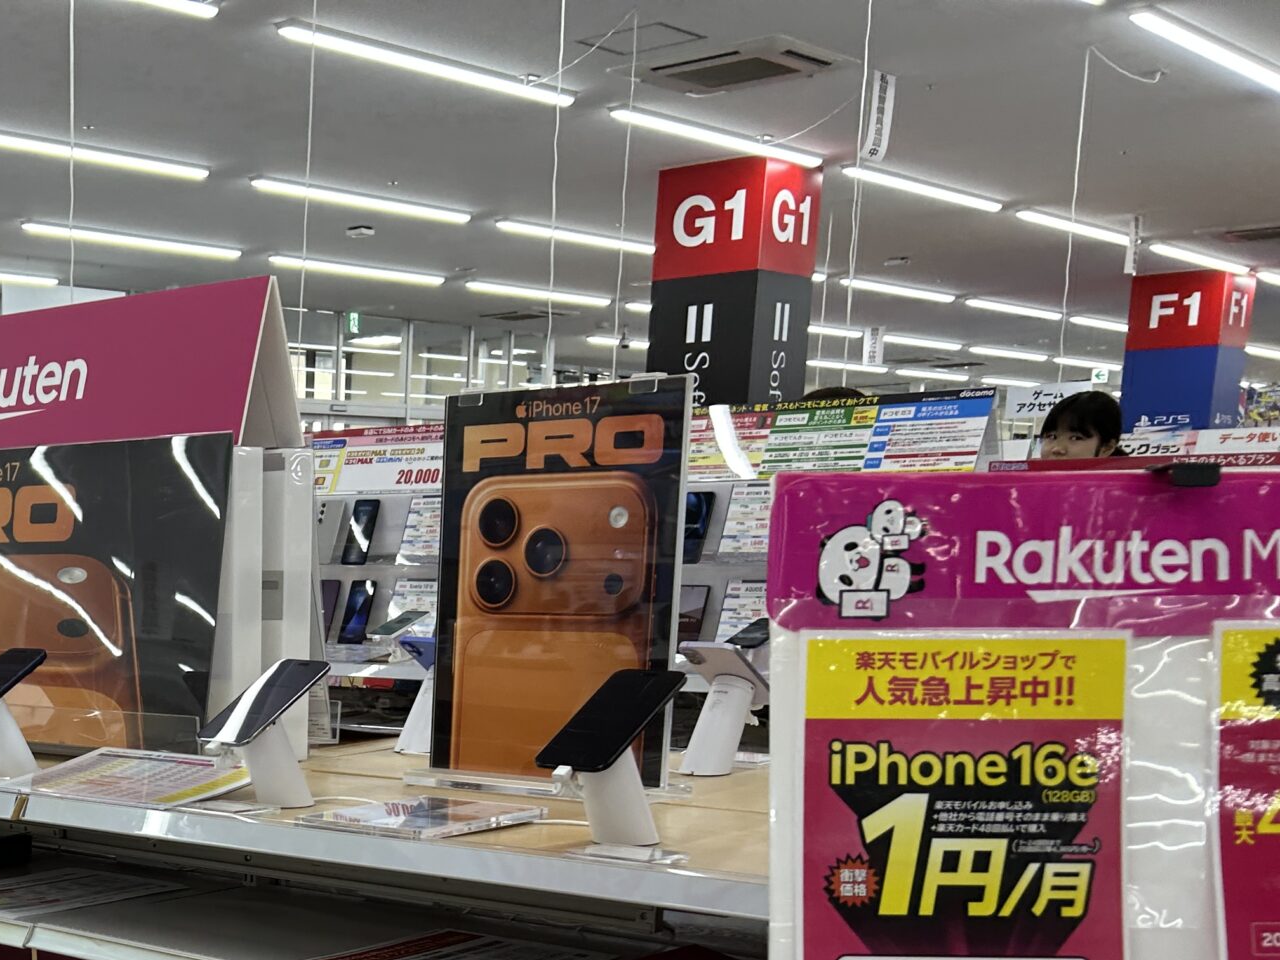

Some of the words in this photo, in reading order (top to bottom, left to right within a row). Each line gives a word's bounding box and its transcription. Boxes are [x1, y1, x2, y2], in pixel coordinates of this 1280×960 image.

[672, 188, 747, 248] G1
[771, 188, 812, 247] G1
[1149, 291, 1202, 329] F1
[1228, 291, 1248, 328] F1
[959, 389, 995, 398] docomo
[528, 399, 582, 420] iPhone
[584, 397, 601, 415] 17
[1153, 414, 1190, 424] PS5
[462, 414, 664, 472] PRO
[4, 462, 20, 482] 17
[396, 468, 440, 485] 20,000
[974, 526, 1229, 588] Rakuten
[855, 650, 1077, 671] 楽天モバイルショップで
[854, 676, 1076, 707] 人気急上昇中!!
[830, 741, 1007, 787] iPhone
[1012, 744, 1099, 787] 16e
[1041, 790, 1097, 804] (128GB)
[840, 868, 867, 882] 衝撃
[840, 883, 867, 897] 価格
